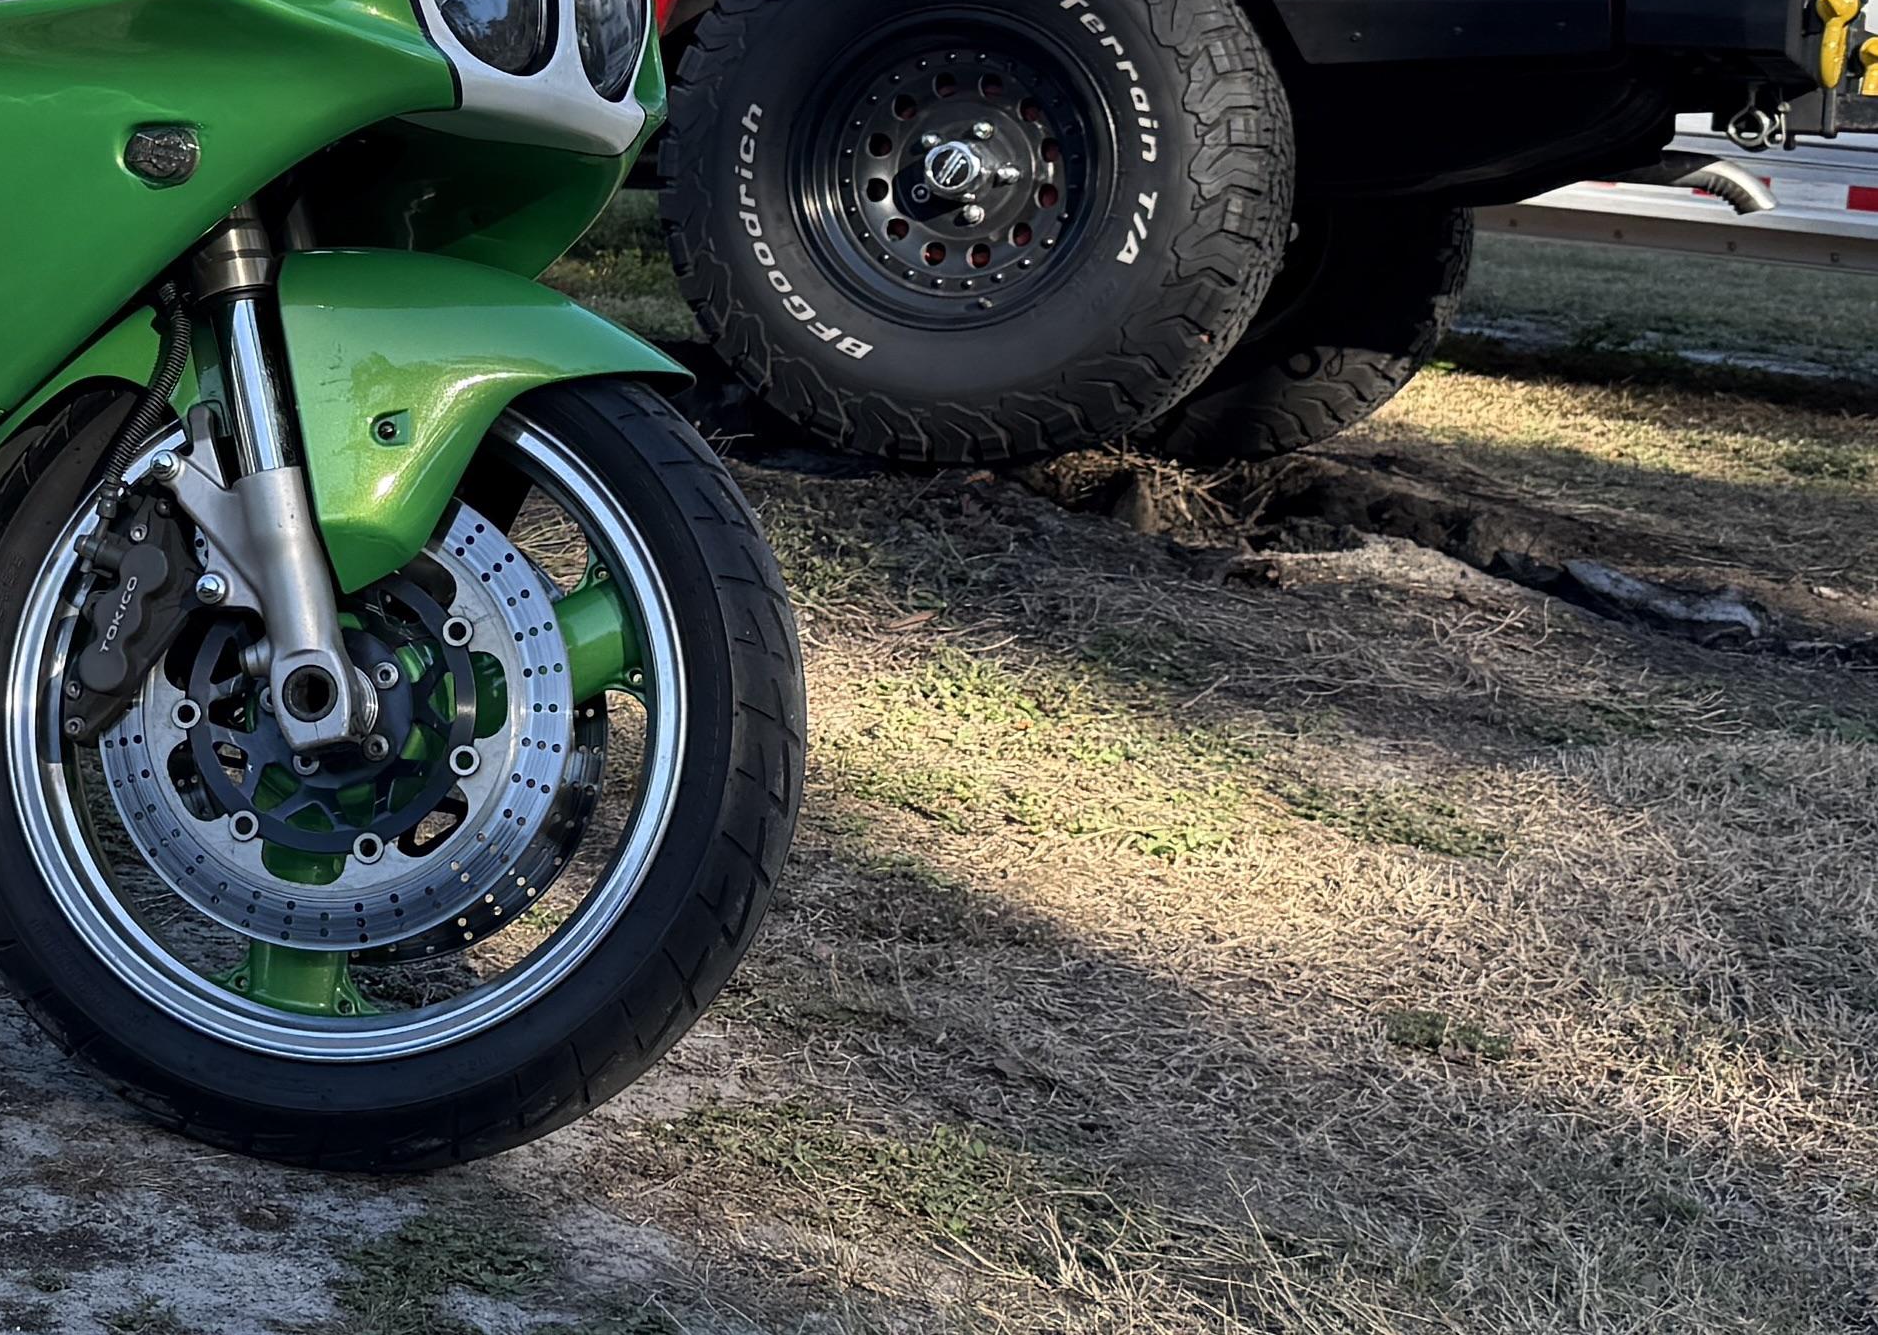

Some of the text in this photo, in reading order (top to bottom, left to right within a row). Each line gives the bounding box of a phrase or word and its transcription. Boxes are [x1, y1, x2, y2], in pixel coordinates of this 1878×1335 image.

[733, 101, 873, 361] BFGoodrich
[1115, 189, 1159, 266] T/A
[99, 575, 138, 652] TOKICO
